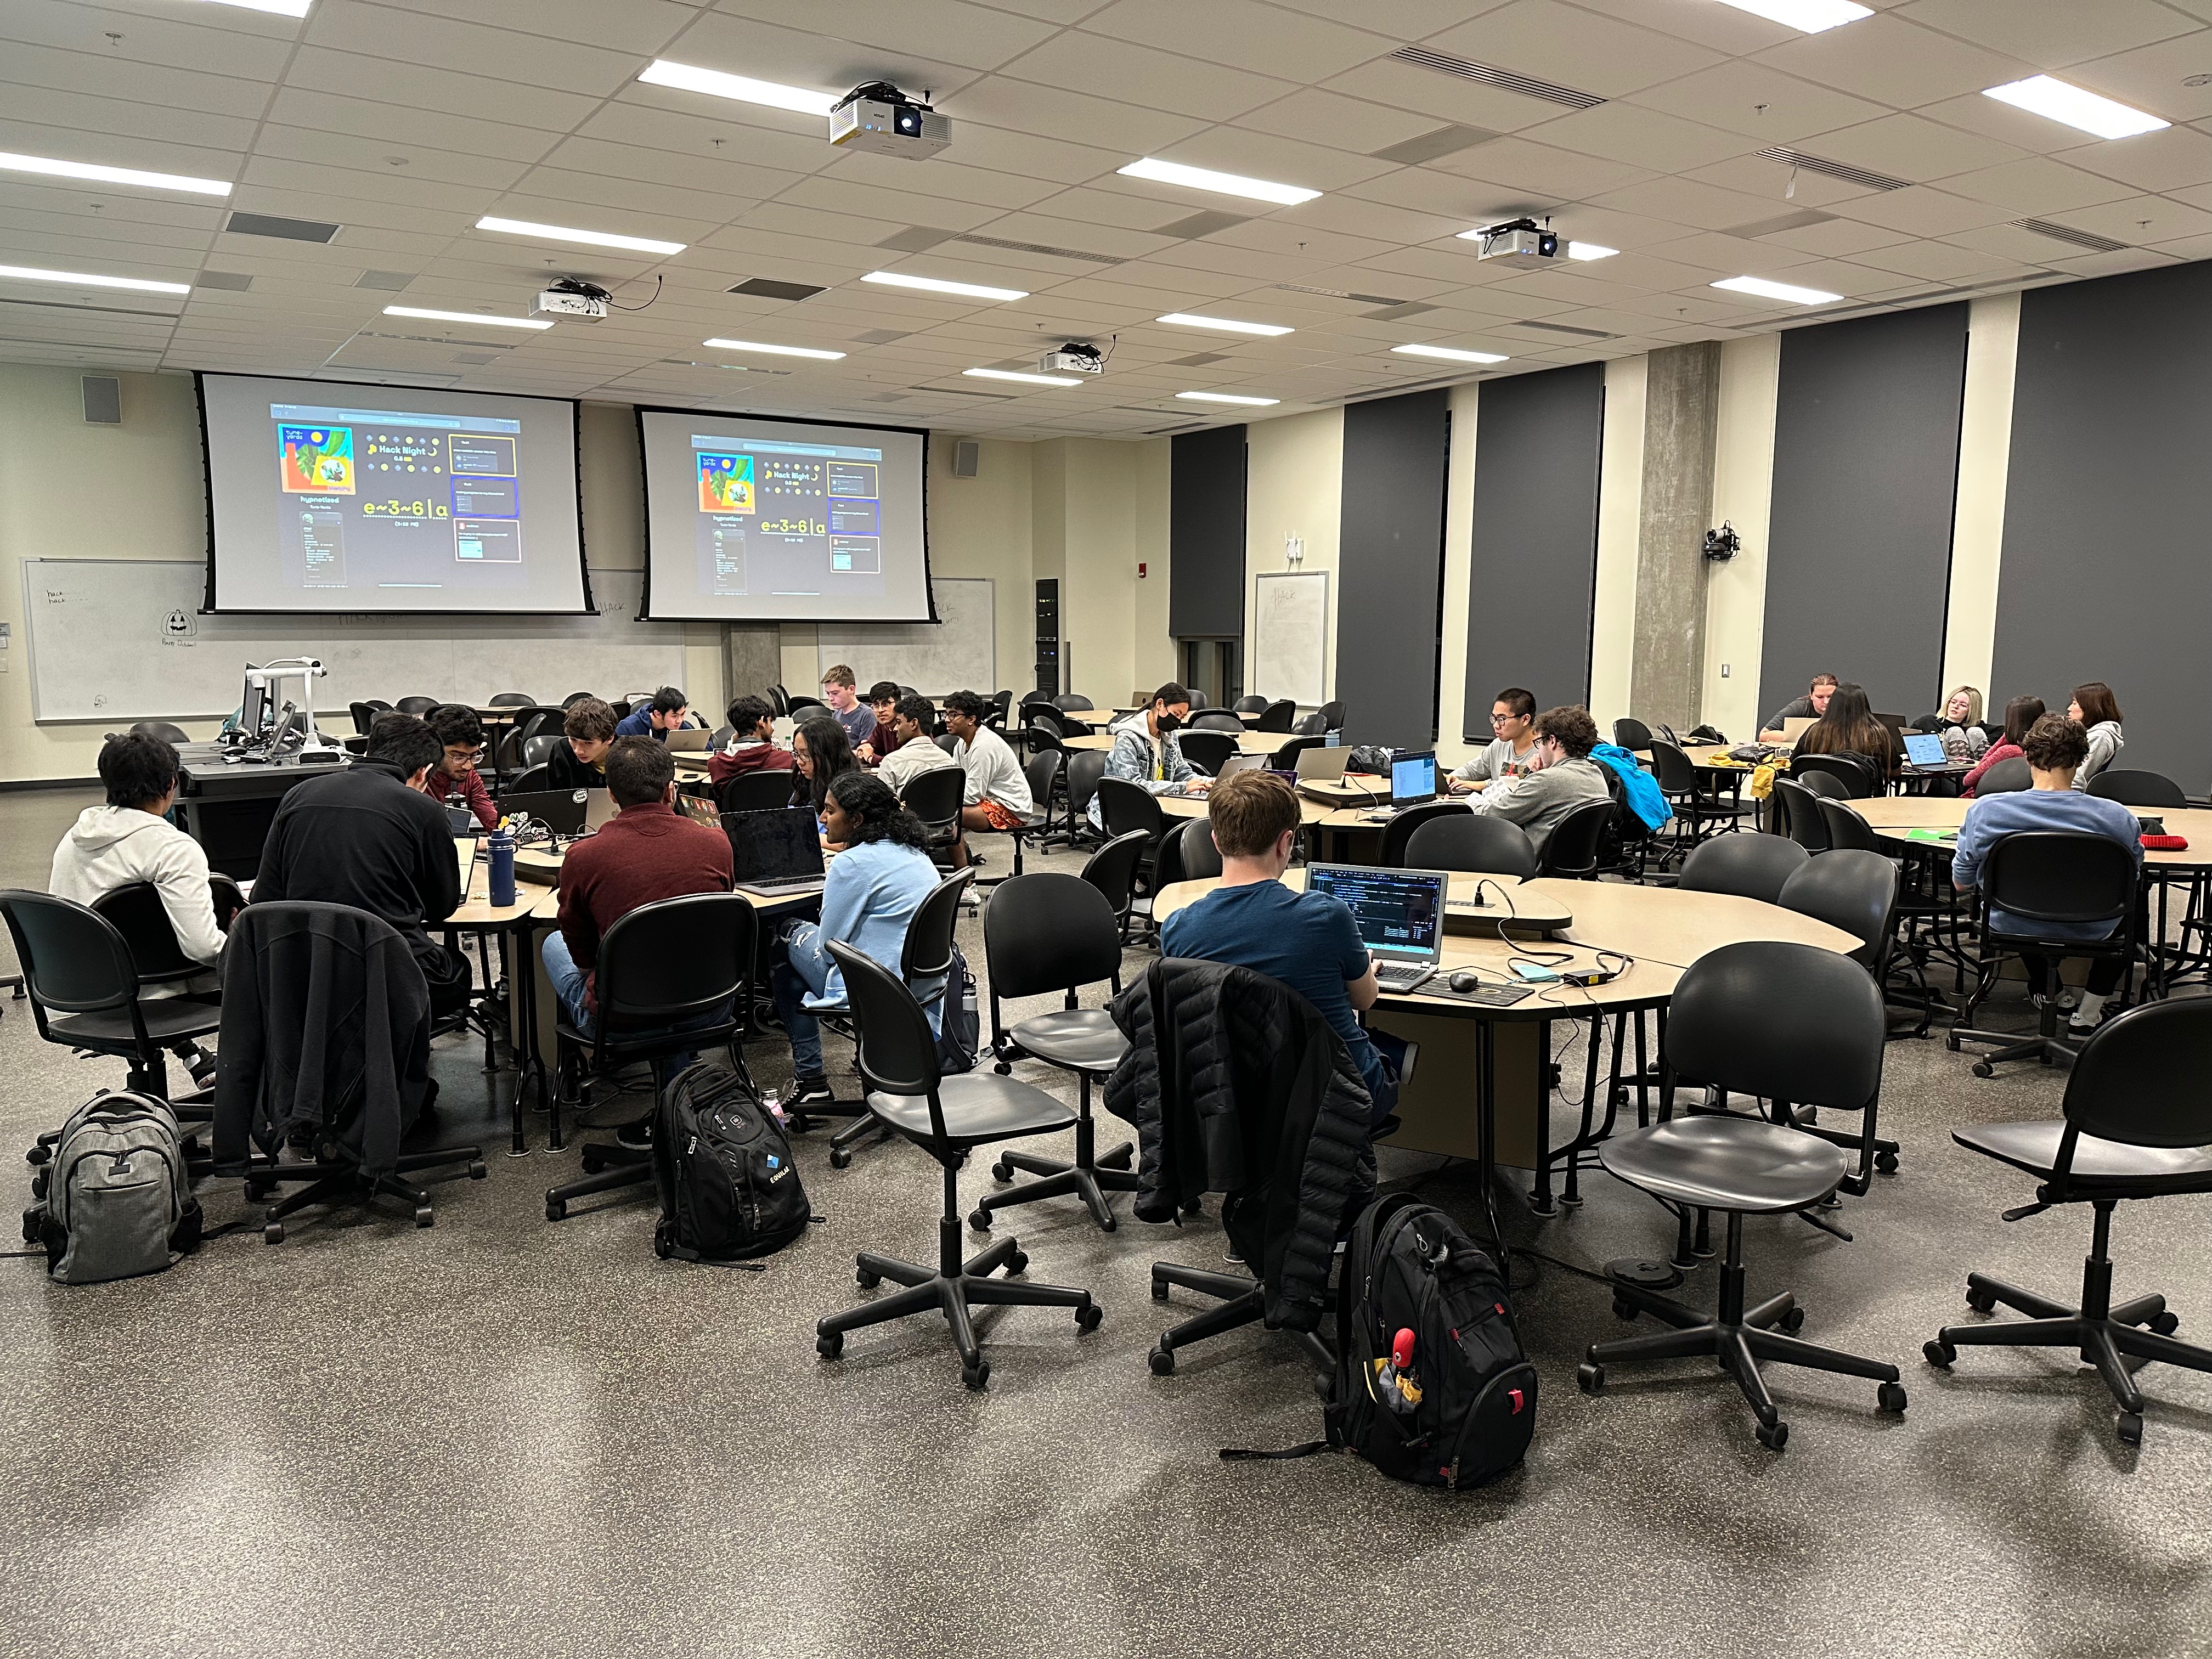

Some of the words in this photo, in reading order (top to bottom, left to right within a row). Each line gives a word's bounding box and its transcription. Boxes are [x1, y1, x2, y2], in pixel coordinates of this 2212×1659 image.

[379, 445, 401, 454] Hack
[402, 447, 426, 456] Night
[791, 472, 810, 481] Night
[1274, 588, 1296, 610] HACK
[599, 602, 627, 617] HACK
[936, 602, 955, 616] ACK
